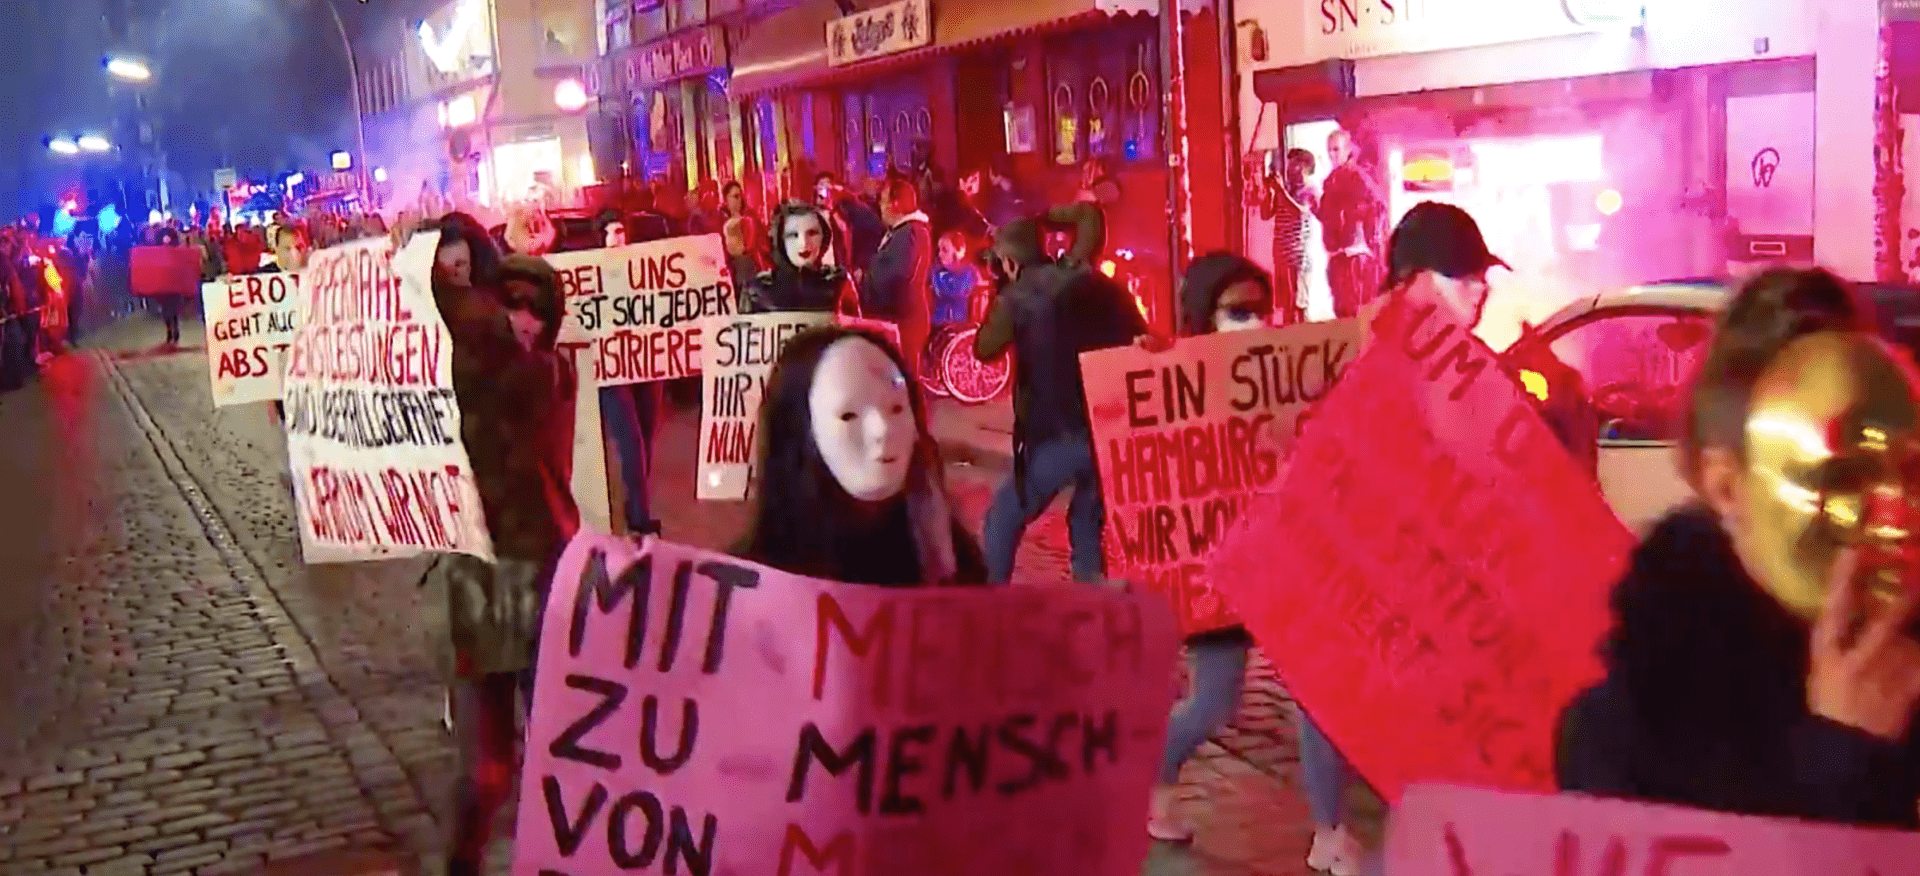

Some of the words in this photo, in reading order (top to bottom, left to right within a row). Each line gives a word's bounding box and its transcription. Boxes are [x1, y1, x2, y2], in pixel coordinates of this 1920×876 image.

[556, 266, 602, 296] BEI
[628, 253, 686, 290] UNS
[613, 294, 655, 327] SICH
[659, 281, 732, 327] JEDER
[214, 312, 262, 341] GEHT
[268, 311, 296, 333] AUC
[1402, 304, 1488, 400] UM
[712, 373, 752, 417] IHR
[1125, 359, 1205, 428] EIN
[1230, 339, 1348, 411] STÜCK
[707, 420, 755, 463] NUN
[1109, 413, 1278, 505] HAMBURG
[1112, 505, 1179, 565] WIR
[568, 547, 760, 674] MIT
[549, 674, 698, 775] ZU
[542, 775, 718, 876] VON
